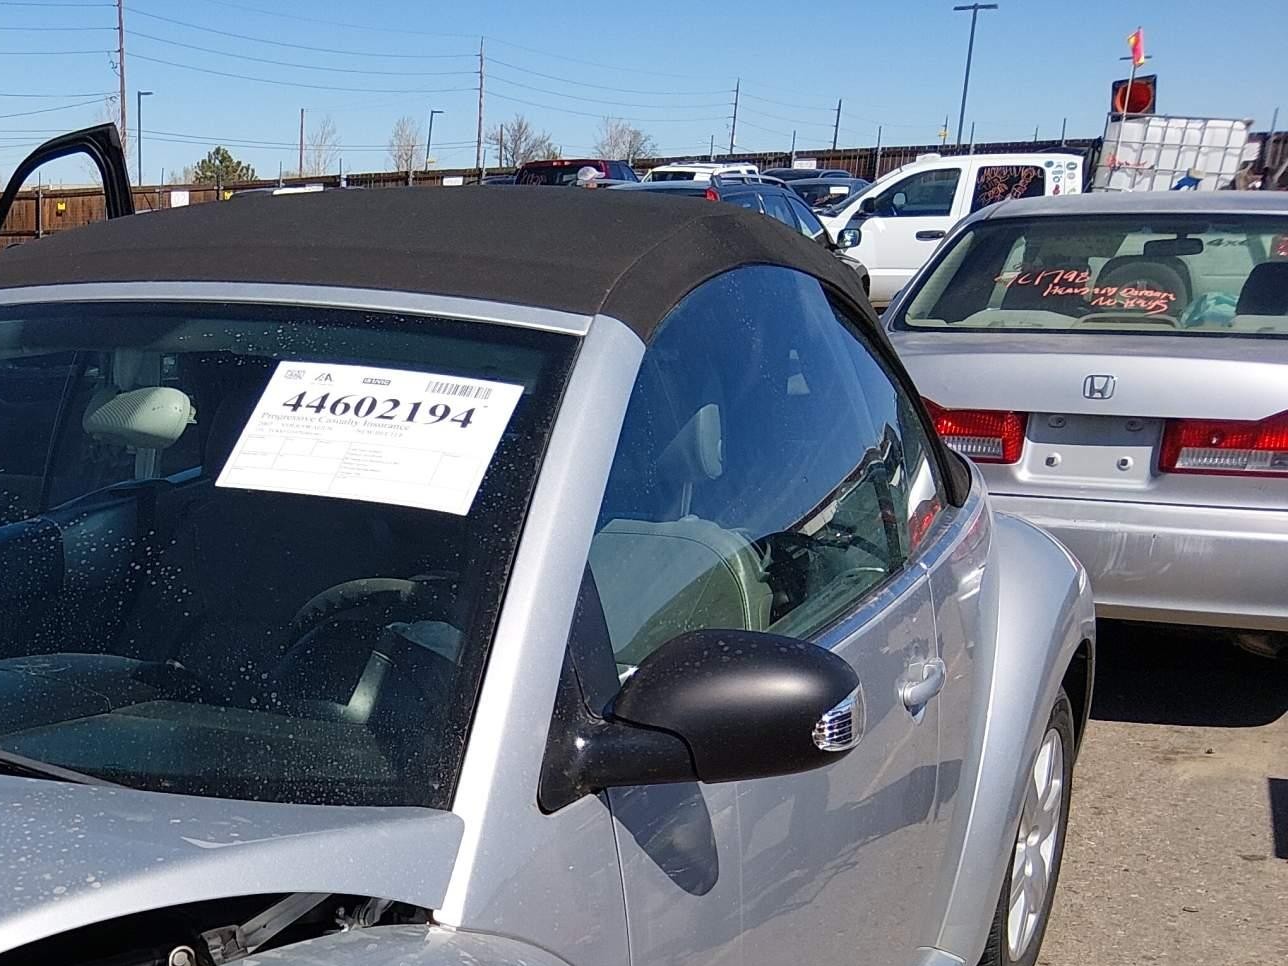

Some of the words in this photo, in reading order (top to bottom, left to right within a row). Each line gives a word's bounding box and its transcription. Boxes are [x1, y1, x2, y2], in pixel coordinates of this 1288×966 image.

[261, 412, 318, 423] Progressive
[318, 417, 360, 427] Casualty
[362, 419, 411, 431] Insurance
[283, 391, 476, 428] 44602194
